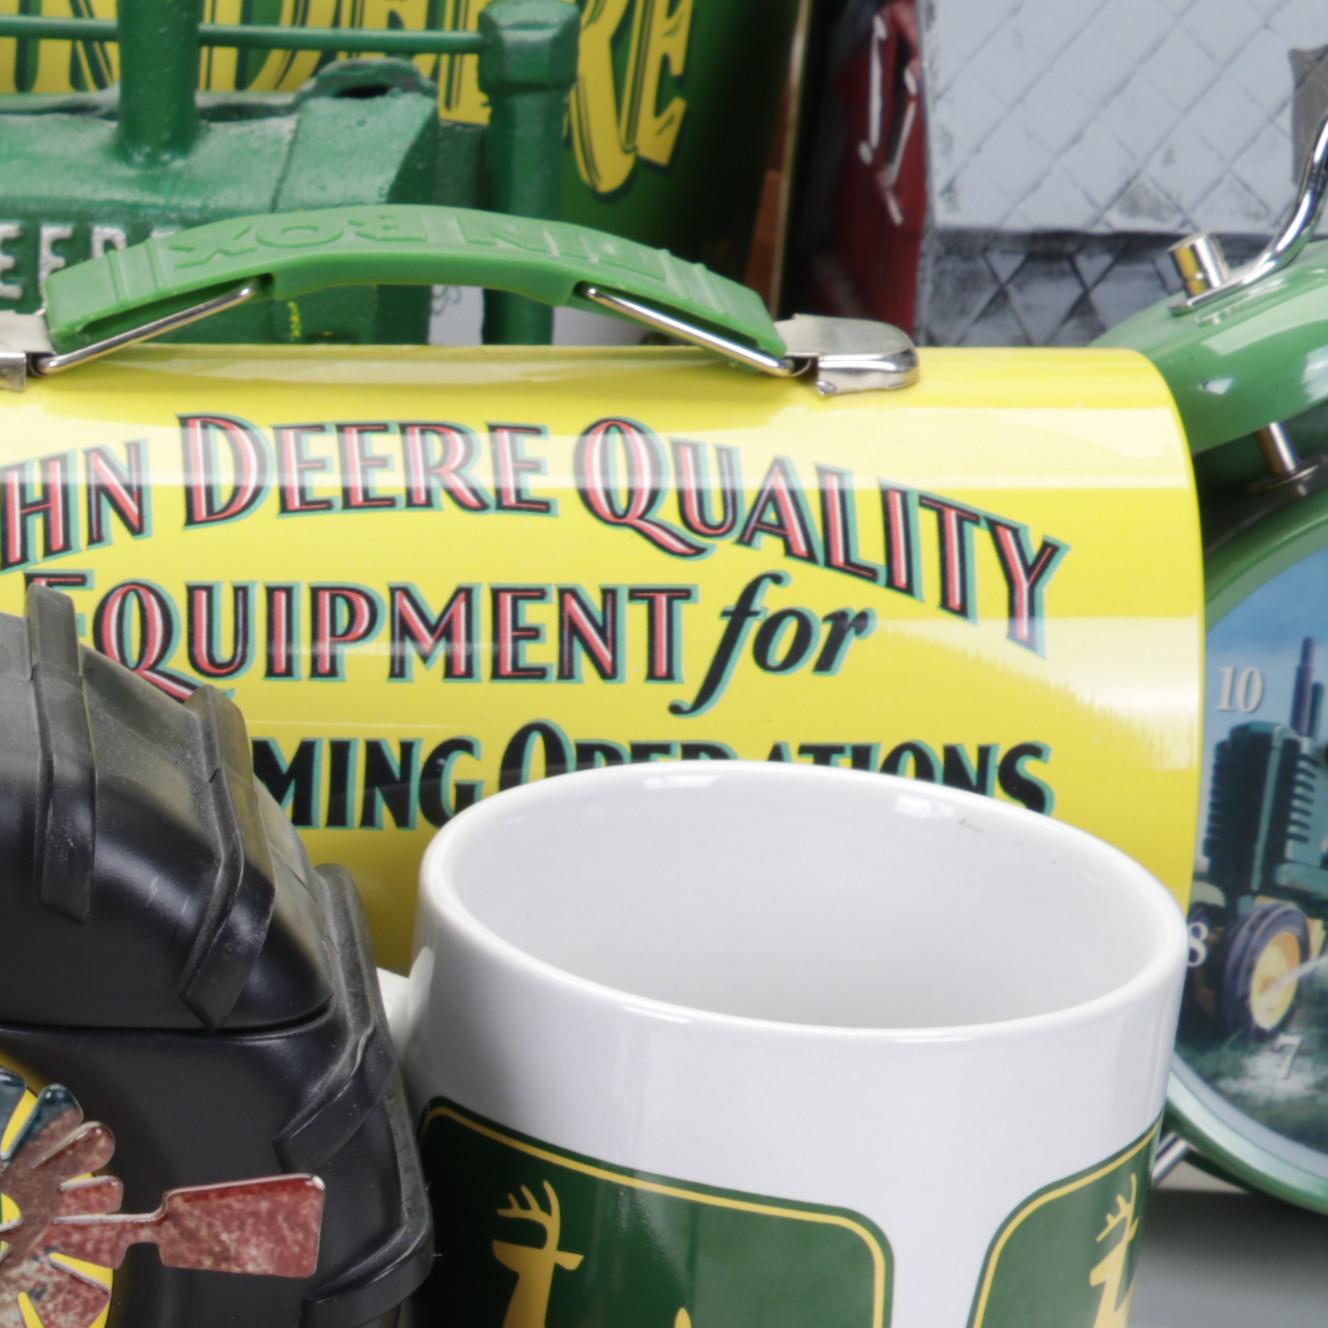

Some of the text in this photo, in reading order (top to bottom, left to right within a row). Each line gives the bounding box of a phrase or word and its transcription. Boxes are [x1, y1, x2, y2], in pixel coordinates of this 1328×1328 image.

[175, 412, 558, 528] DEERE
[572, 416, 1071, 660] QUALITY
[25, 568, 877, 717] QUIPMENT for
[1216, 665, 1264, 714] 10
[251, 735, 483, 831] MING
[1276, 1033, 1305, 1081] 7
